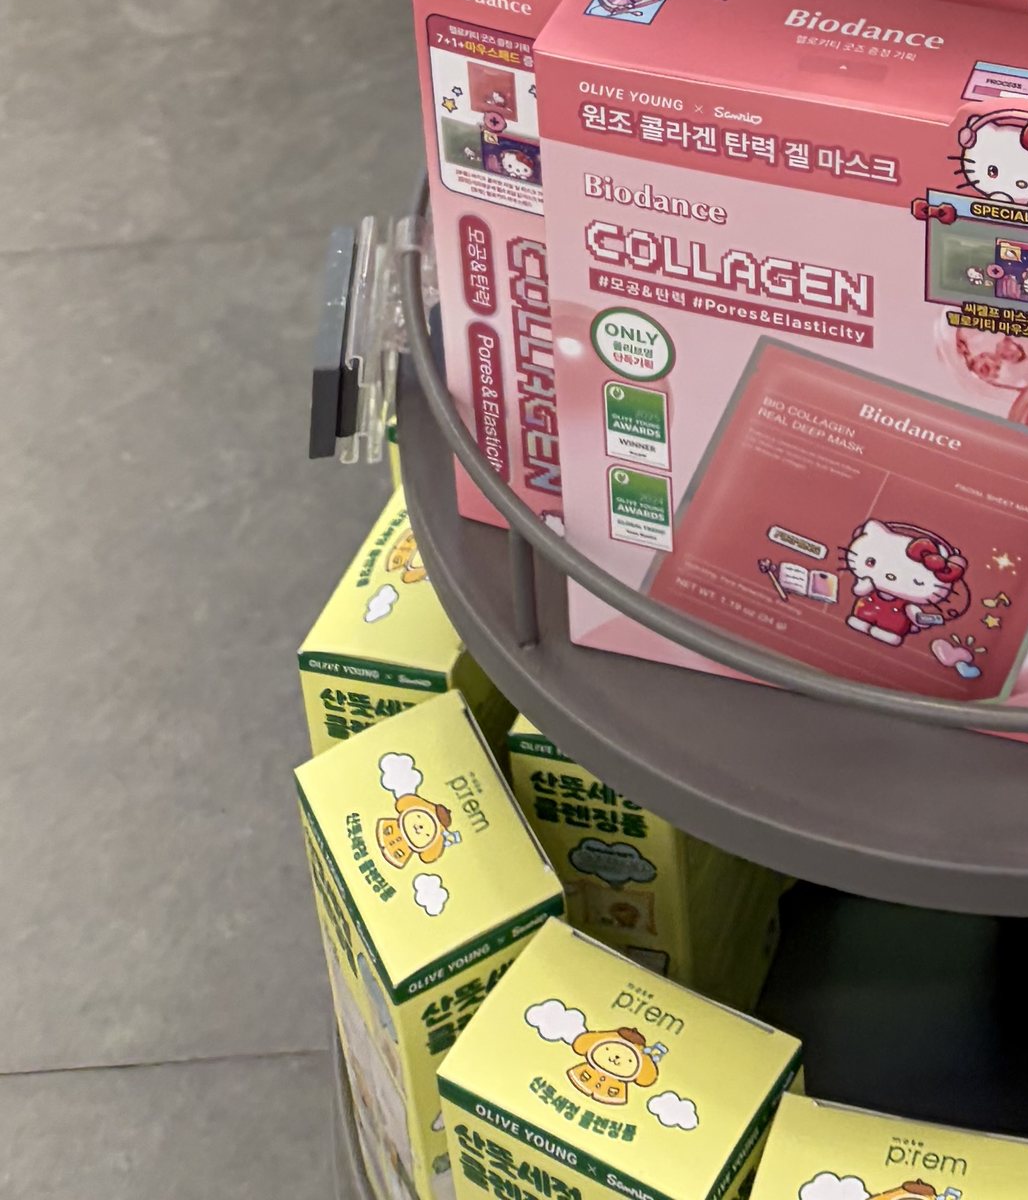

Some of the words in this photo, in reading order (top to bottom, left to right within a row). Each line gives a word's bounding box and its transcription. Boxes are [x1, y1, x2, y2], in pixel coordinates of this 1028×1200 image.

[784, 8, 945, 52] Biodance
[579, 81, 624, 100] OLIVE
[630, 90, 683, 111] YOUNG
[583, 104, 632, 134] 원조
[640, 116, 716, 152] 콜라겐
[724, 134, 775, 163] 탄력
[785, 144, 810, 169] 겔
[818, 150, 897, 182] 마스크
[584, 173, 726, 224] Biodance
[468, 226, 491, 307] 모공&탄력
[586, 220, 874, 317] COLLAGEN
[599, 275, 685, 306] #모공&탄력
[693, 296, 865, 342] #Pores&Elasticity
[948, 313, 995, 331] 헬로키티
[604, 323, 658, 345] ONLY
[613, 421, 661, 438] AWARDS
[758, 409, 789, 424] REAL
[792, 419, 825, 440] DEEP
[828, 433, 864, 454] MASK
[763, 396, 784, 410] BIO
[789, 403, 855, 437] COLLAGEN
[859, 403, 962, 451] Biodance
[619, 437, 656, 453] WINNER
[617, 504, 665, 522] AWARDS
[320, 688, 420, 719] 산뜻세
[534, 796, 648, 838] 클렌징폼
[408, 970, 444, 994] OLIVE
[449, 944, 490, 972] YOUNG
[475, 1104, 521, 1134] OLIVE
[525, 1128, 578, 1166] YOUNG
